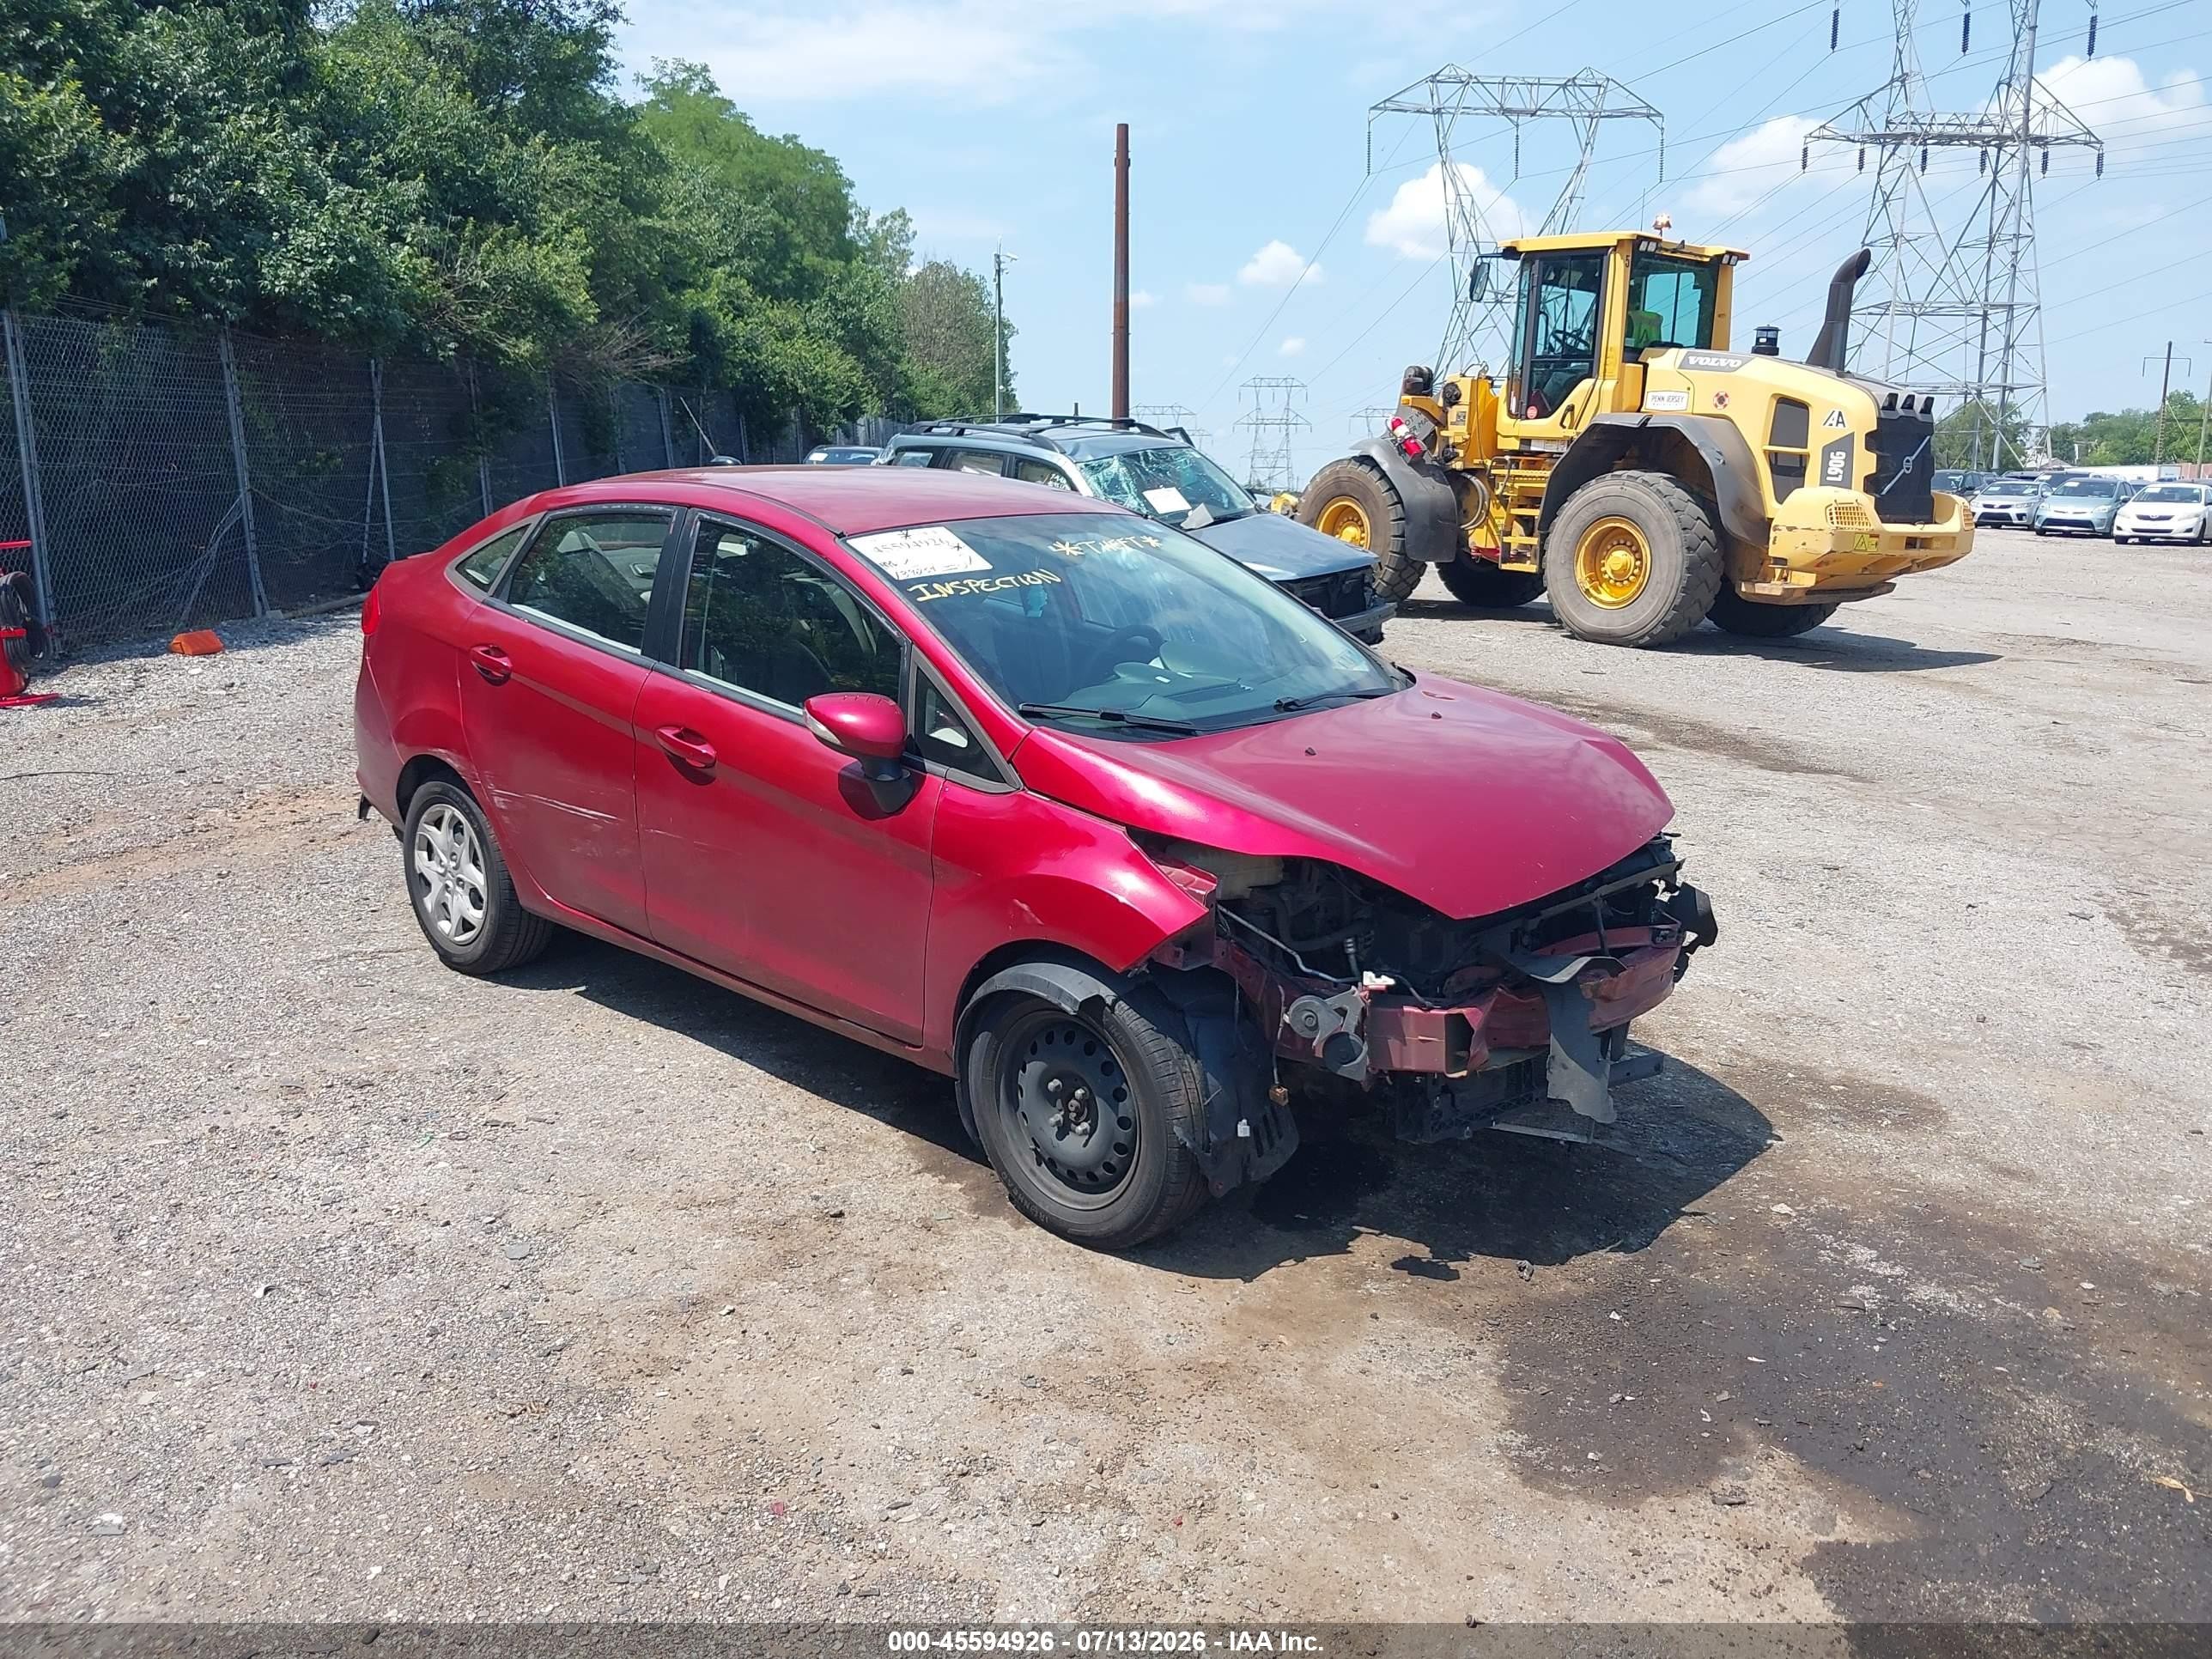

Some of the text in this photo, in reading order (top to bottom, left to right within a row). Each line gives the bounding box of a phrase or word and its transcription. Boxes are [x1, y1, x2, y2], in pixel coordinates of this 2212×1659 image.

[1687, 356, 1742, 368] VOLVO
[1826, 451, 1846, 482] L90G
[907, 568, 1062, 602] INSPECTION
